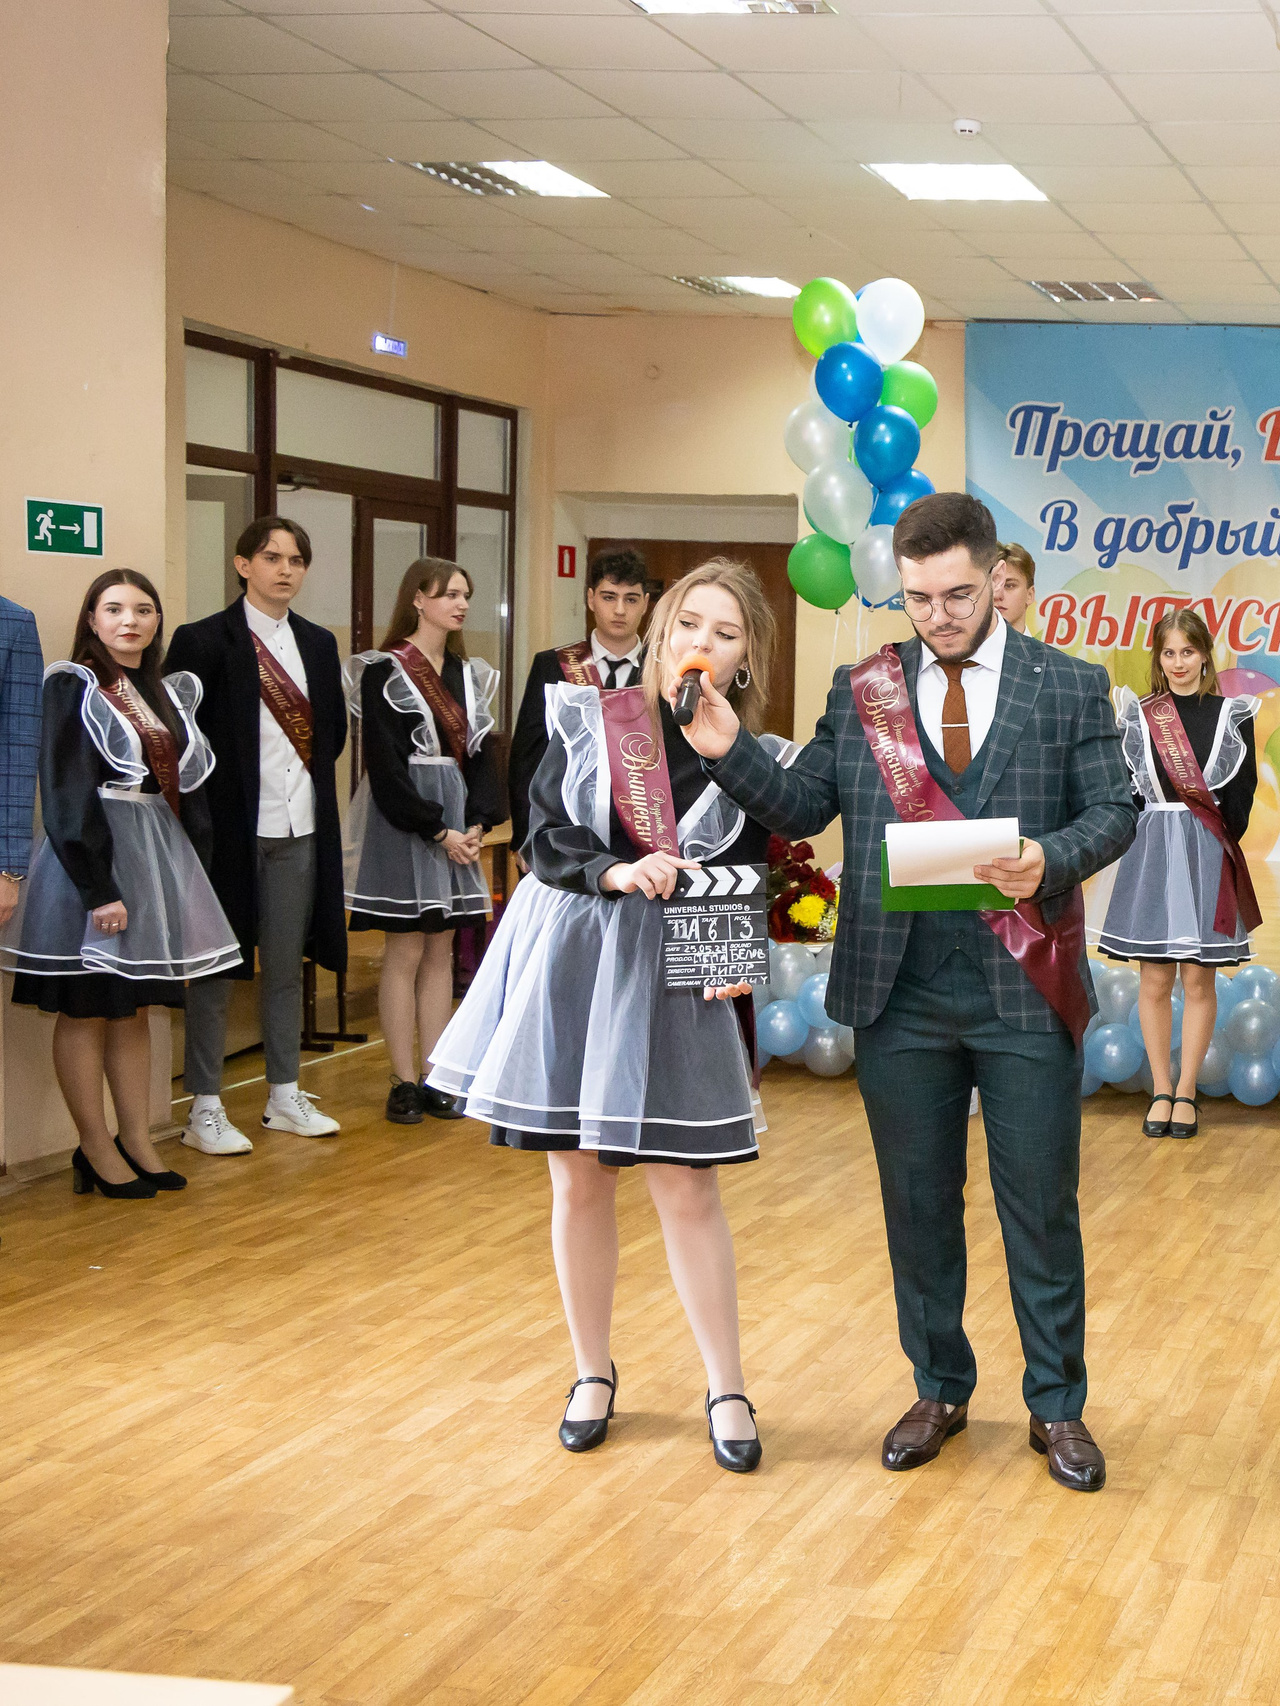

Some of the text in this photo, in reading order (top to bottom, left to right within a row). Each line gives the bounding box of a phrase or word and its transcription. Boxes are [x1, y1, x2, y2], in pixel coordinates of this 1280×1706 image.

[1008, 404, 1242, 473] Прощай,
[1040, 500, 1078, 552] В
[862, 676, 914, 798] Выпускник
[906, 799, 935, 822] 20
[1151, 701, 1189, 781] Выпускница
[619, 732, 662, 848] Выпускн
[664, 903, 743, 914] UNIVERSAL STUDIOS
[708, 920, 718, 941] 6
[739, 920, 754, 940] 3
